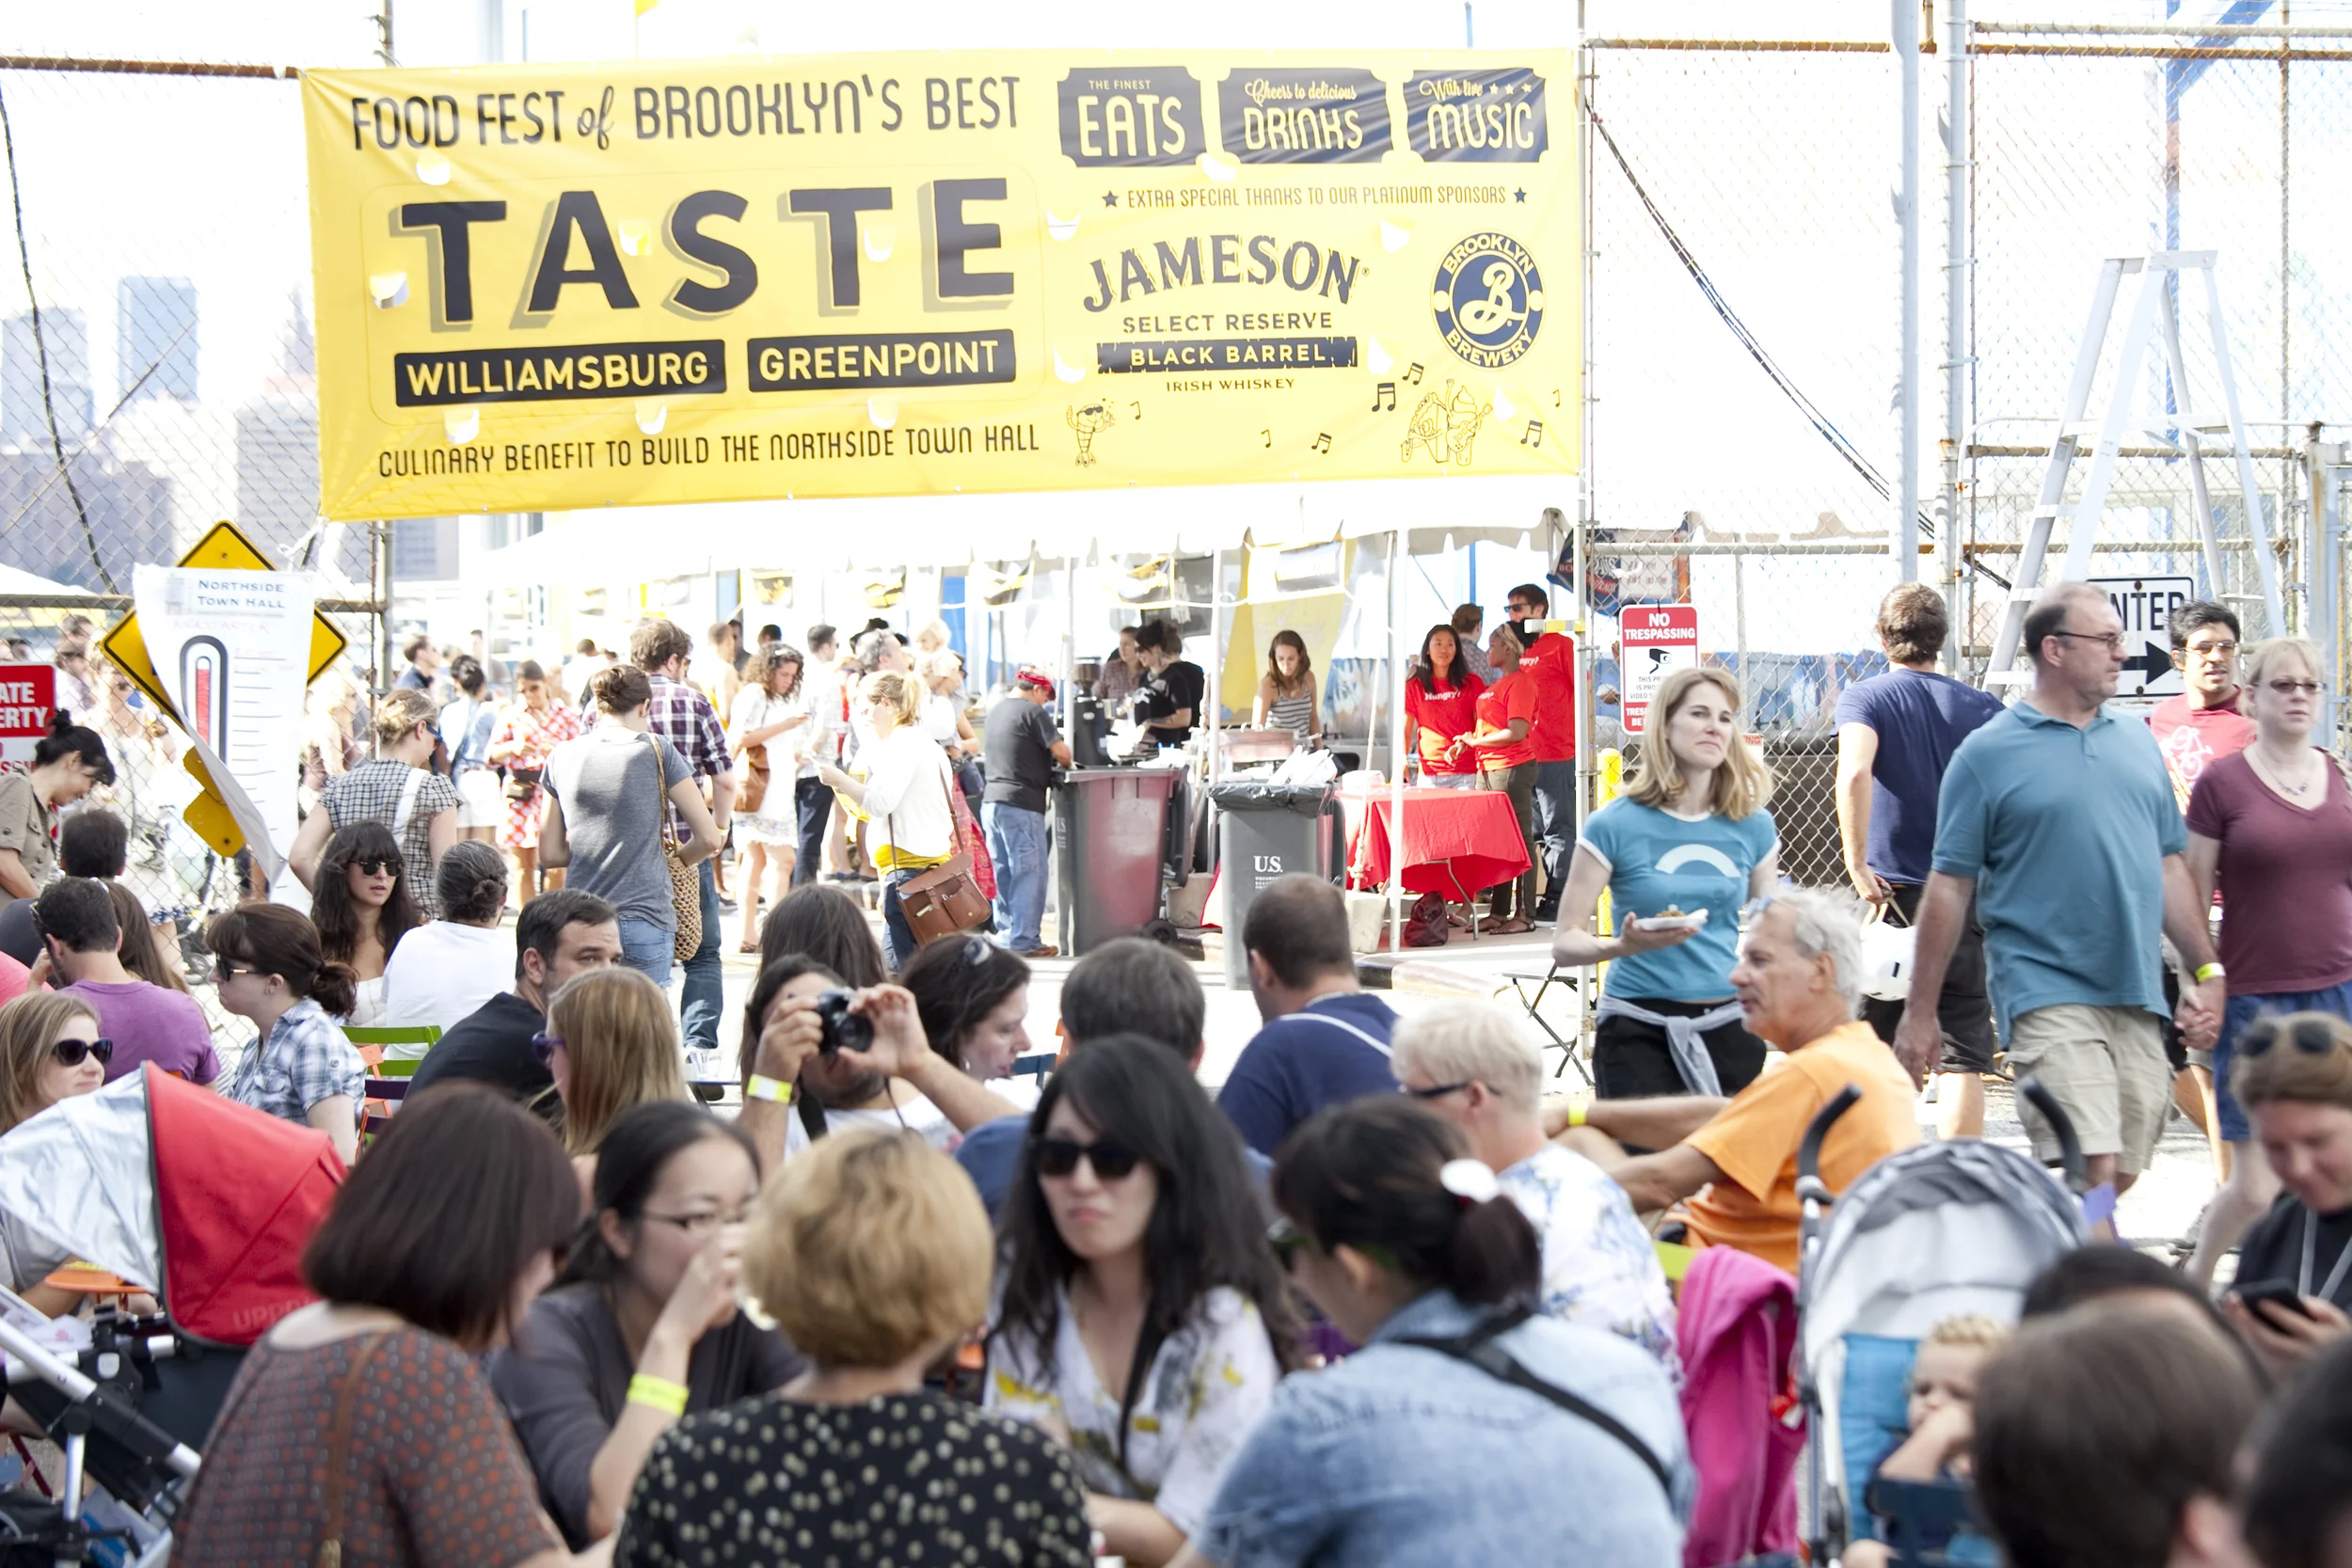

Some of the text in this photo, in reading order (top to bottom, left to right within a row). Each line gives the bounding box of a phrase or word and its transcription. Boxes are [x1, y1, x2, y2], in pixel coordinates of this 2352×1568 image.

[1089, 79, 1152, 90] THE FINEST
[1244, 78, 1358, 107] Cheers to delicious
[1419, 78, 1484, 102] With live
[353, 73, 1020, 150] FOOD FEST of BROOKLYN'S BEST
[1077, 94, 1186, 157] EATS
[1243, 106, 1363, 150] DRINKS
[1426, 102, 1534, 150] MUSIC
[1128, 185, 1506, 208] EXTRA SPECIAL THANKS TO OUR PLATINUM SPONSORS
[391, 178, 1014, 329] TASTE
[1442, 233, 1535, 276] BROOKLYN
[1084, 234, 1360, 312] JAMESON
[1122, 311, 1333, 333] SELECT RESERVE
[1130, 343, 1327, 367] BLACK BARREL
[1445, 327, 1534, 367] BREWERY
[406, 340, 999, 397] WILLIAMSBURG GREENPOINT
[1166, 378, 1295, 392] IRISH WHISKEY
[378, 424, 1040, 478] CULINARY BENEFIT TO BUILD THE NORTHSIDE TOWN HALL
[199, 579, 284, 593] NORTHSIDE
[198, 595, 285, 608] TOWN HALL
[2109, 591, 2185, 631] NTER
[1648, 612, 1670, 627] NO
[1624, 627, 1696, 641] TRESPASSING
[1425, 690, 1460, 701] Hungry?
[1253, 855, 1283, 873] U.S.
